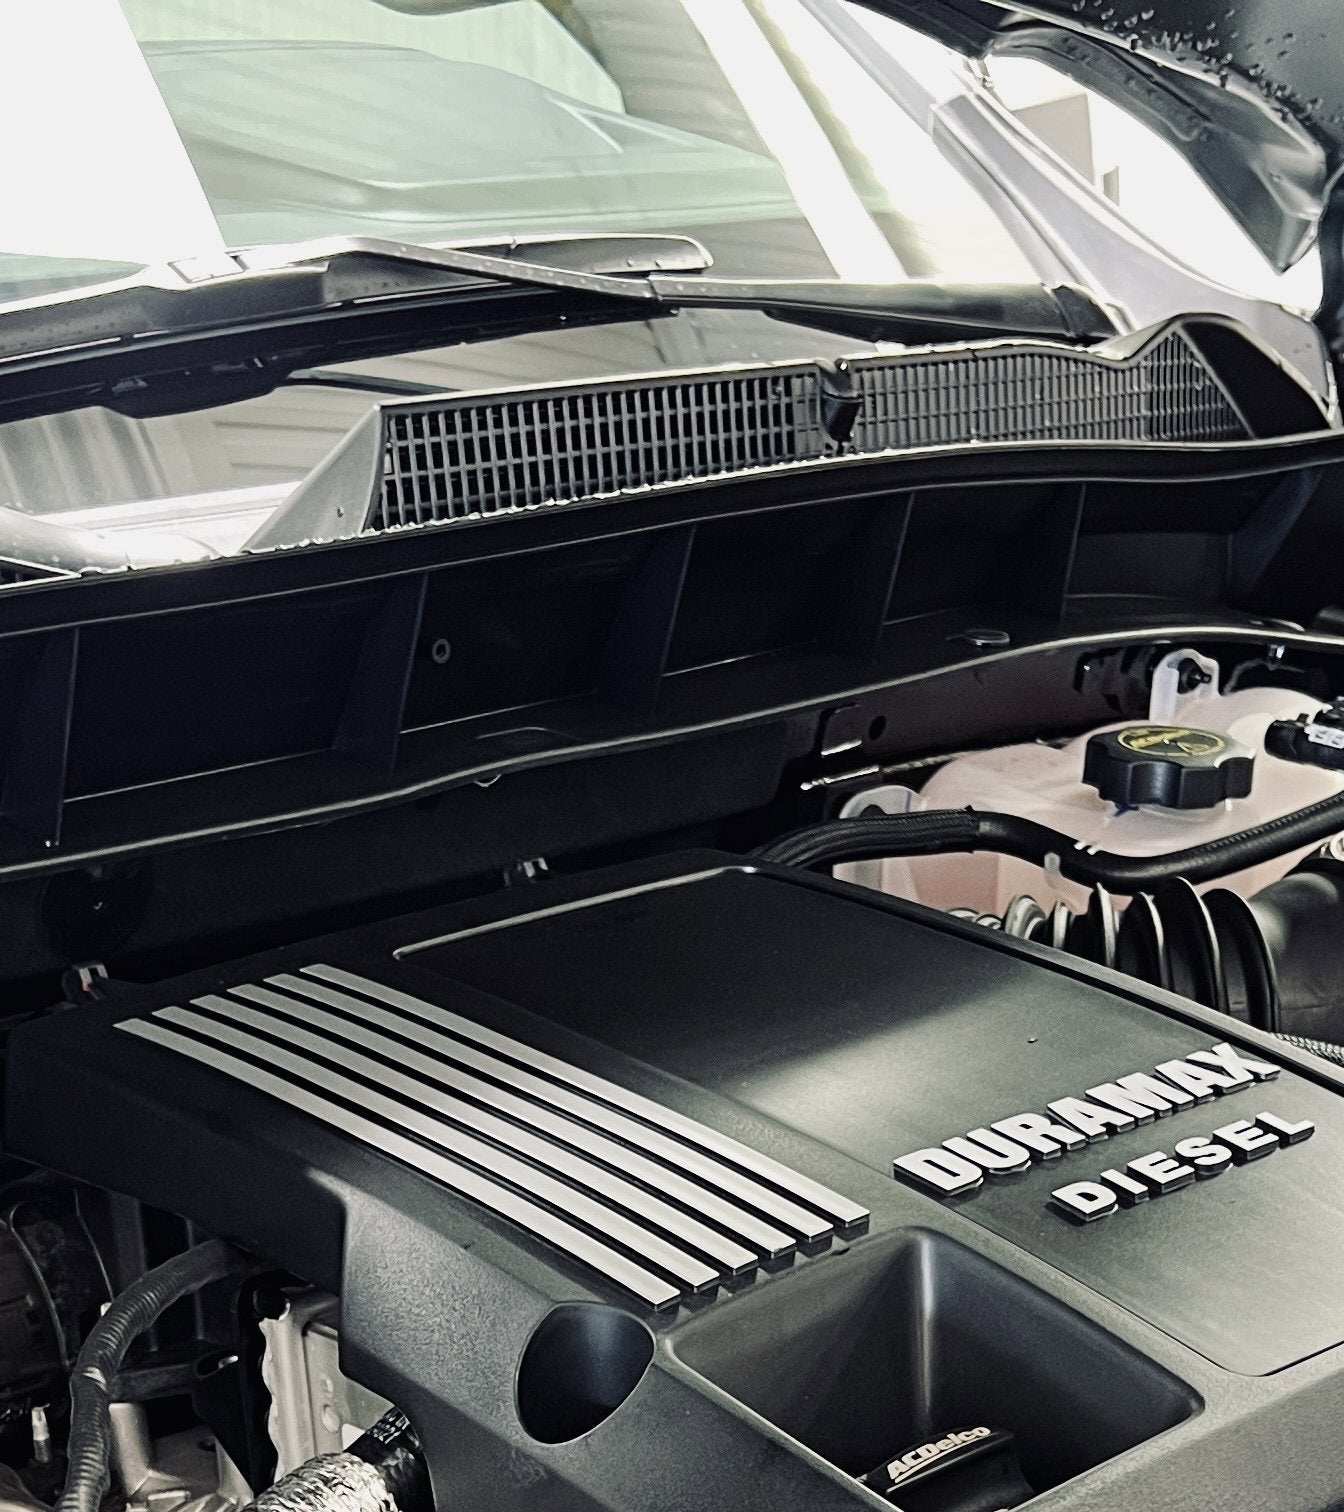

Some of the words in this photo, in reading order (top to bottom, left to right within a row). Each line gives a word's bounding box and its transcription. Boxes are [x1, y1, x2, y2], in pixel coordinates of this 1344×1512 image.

[893, 1041, 1281, 1195] DURAMAX
[1051, 1111, 1315, 1219] DIESEL
[886, 1426, 991, 1480] ACDelco
